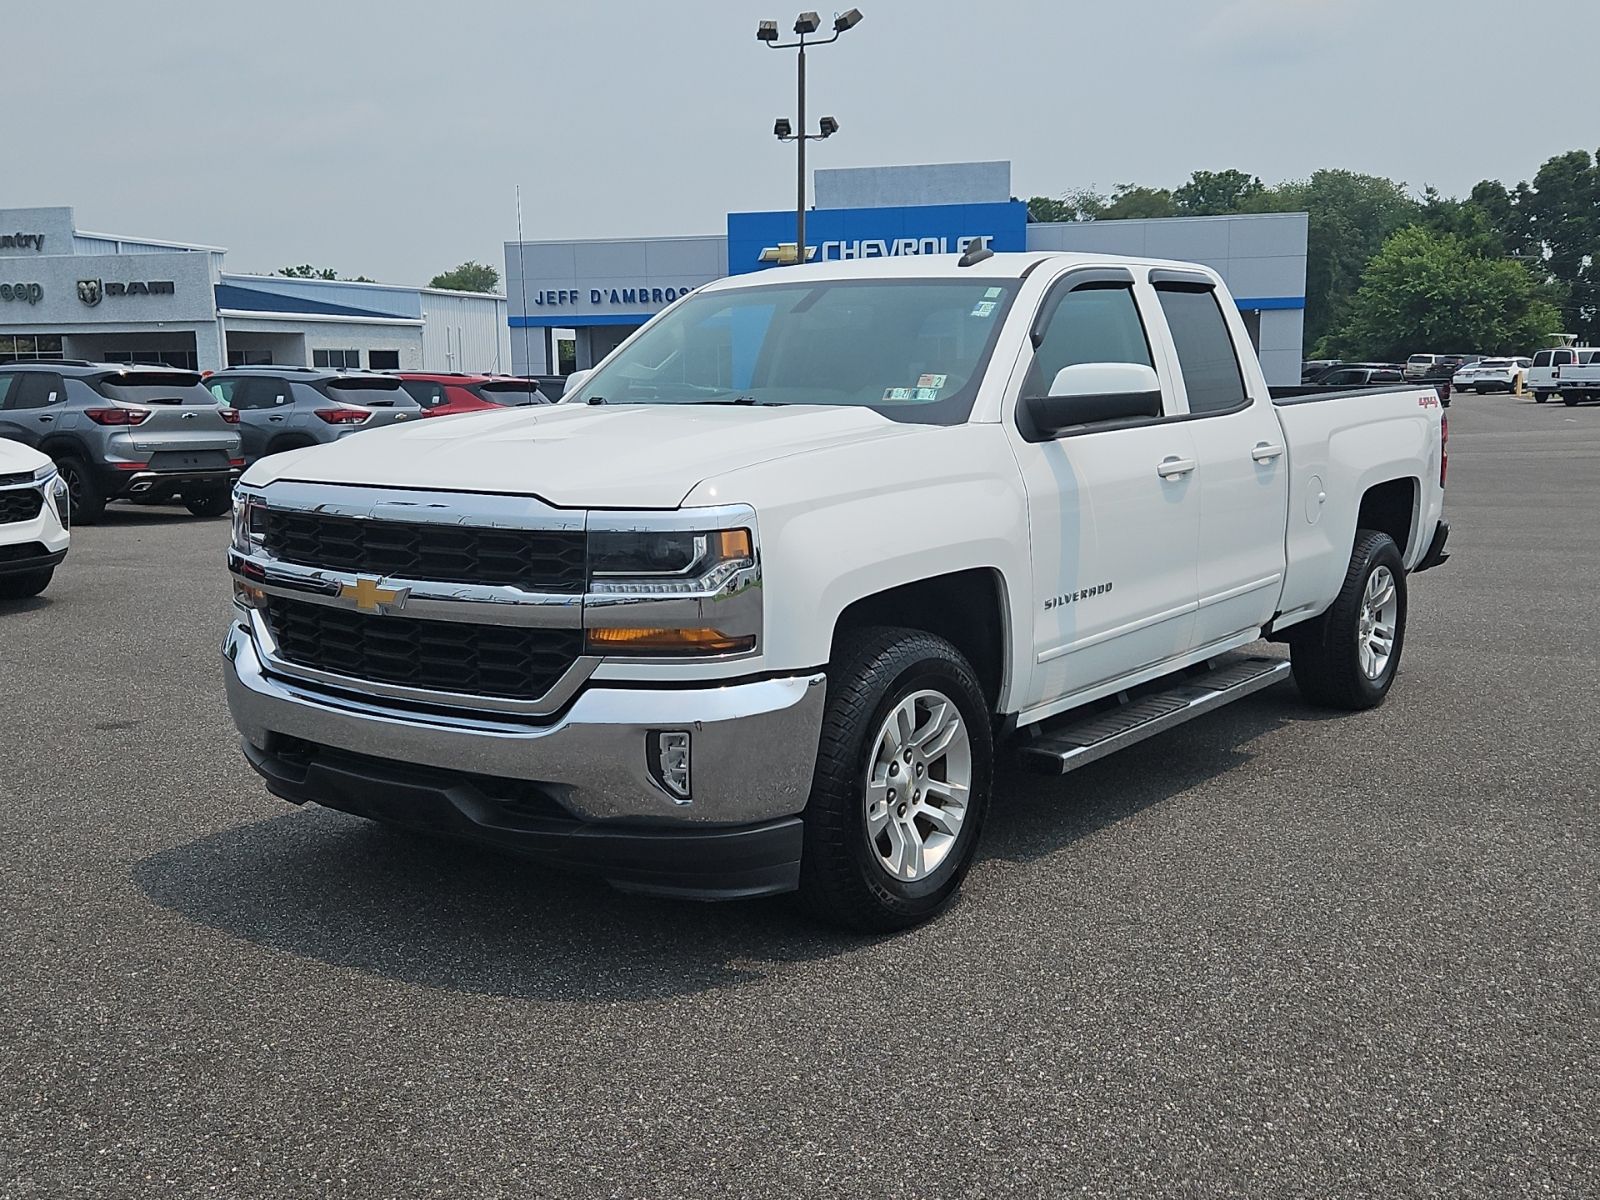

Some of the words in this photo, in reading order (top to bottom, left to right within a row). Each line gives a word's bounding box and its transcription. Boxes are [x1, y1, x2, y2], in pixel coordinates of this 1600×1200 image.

[0, 232, 45, 251] ntry
[822, 235, 994, 262] CHEVROLET
[105, 281, 175, 296] RAM
[535, 290, 578, 305] JEFF
[591, 287, 695, 304] D'AMBROS
[1044, 582, 1113, 610] SILVERADO
